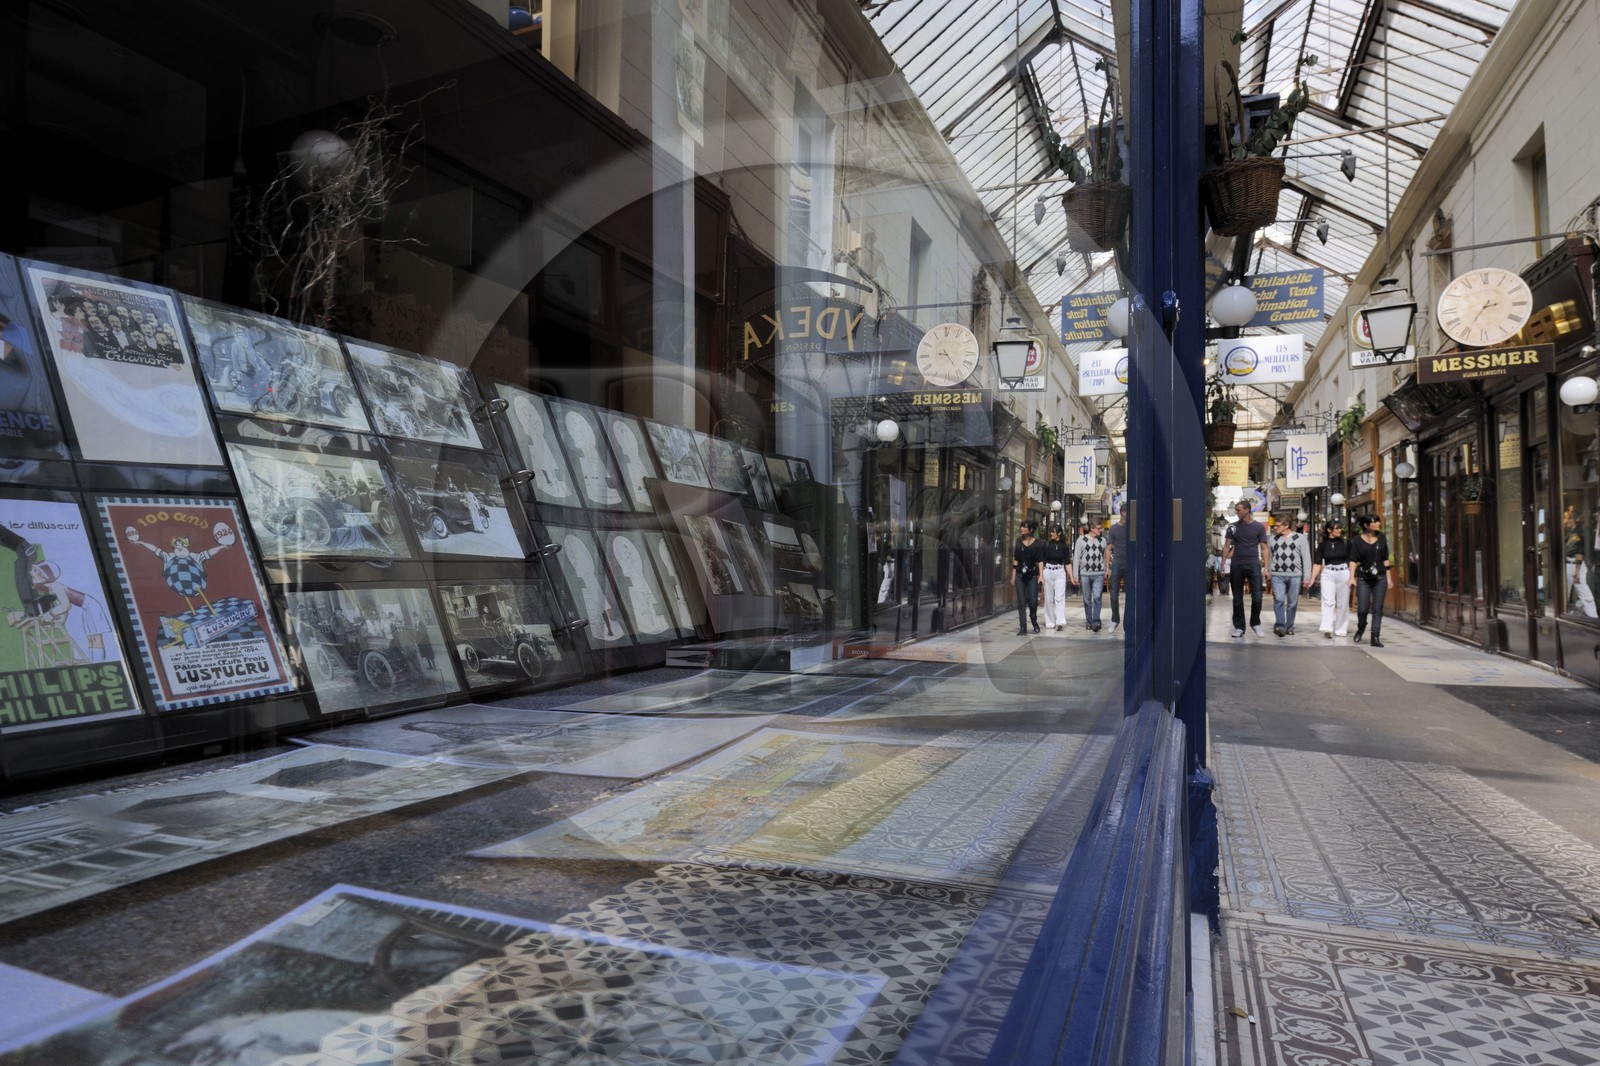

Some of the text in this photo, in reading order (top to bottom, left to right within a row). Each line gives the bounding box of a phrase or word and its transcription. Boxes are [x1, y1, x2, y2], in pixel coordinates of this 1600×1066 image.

[1289, 285, 1318, 297] Vente
[1269, 308, 1320, 322] Gratuite
[1276, 344, 1288, 353] LES
[1264, 353, 1300, 363] MEILLEURS
[1432, 350, 1539, 373] MESSMER
[1271, 365, 1287, 374] PRIX
[8, 520, 80, 530] les diffuseurs
[137, 511, 209, 529] 100 ans
[214, 528, 233, 541] 1924
[173, 663, 202, 671] Pâtes
[217, 657, 242, 666] Œufs
[175, 660, 270, 684] LUSTUCRU
[186, 684, 198, 693] qui
